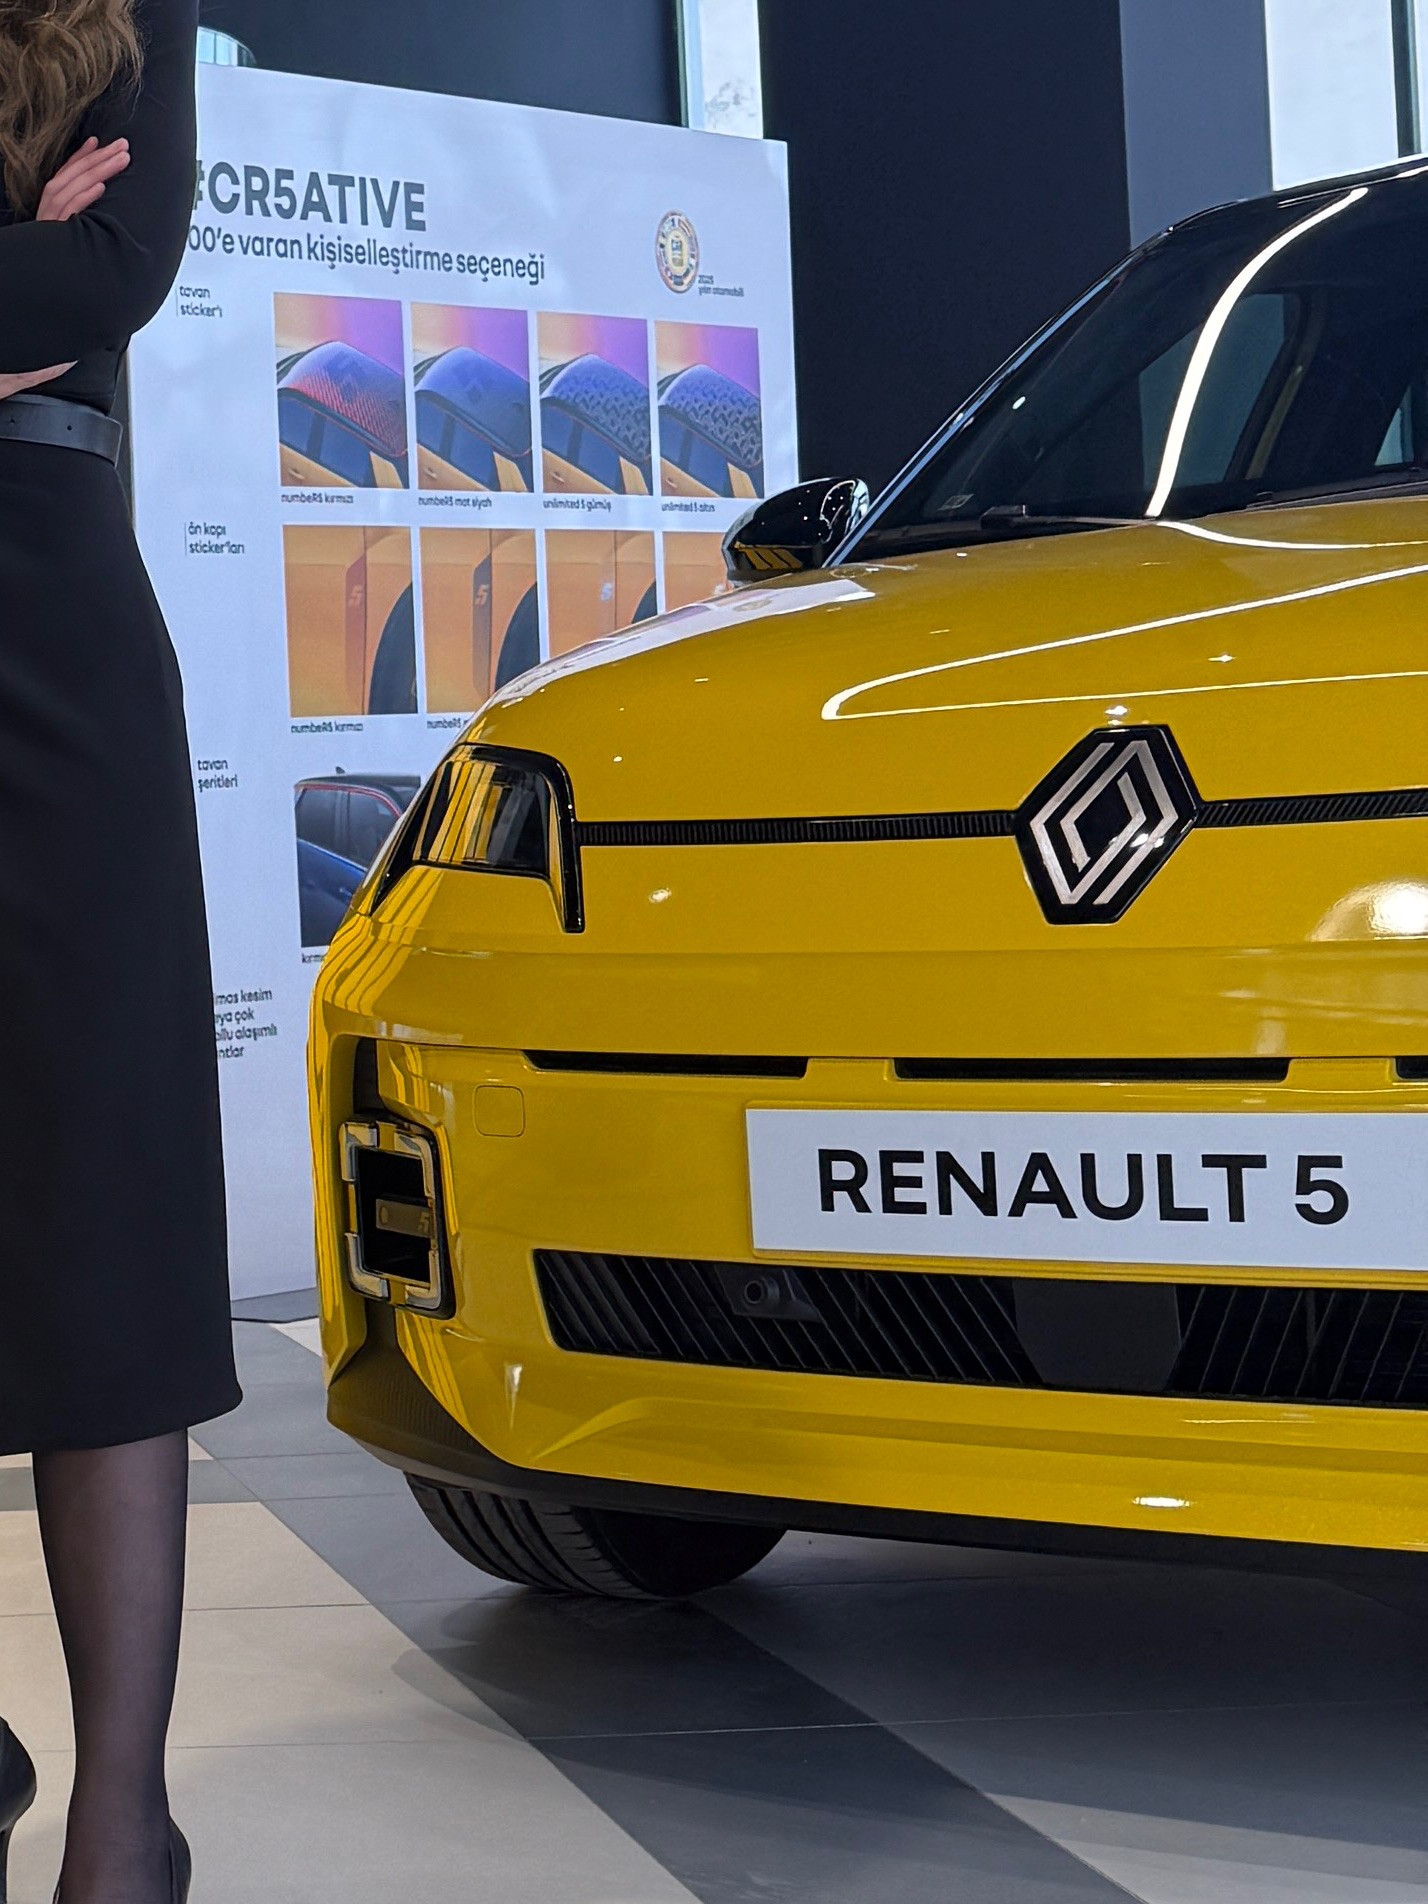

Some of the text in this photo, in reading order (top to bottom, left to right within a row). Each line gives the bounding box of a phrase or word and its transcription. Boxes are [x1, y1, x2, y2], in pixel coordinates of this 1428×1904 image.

[238, 235, 302, 260] varan
[307, 234, 452, 274] kişiselleştirme
[456, 252, 545, 285] seçeneği
[179, 286, 210, 298] tavan
[188, 521, 202, 535] ön
[197, 760, 228, 771] tavan
[240, 988, 272, 1002] kesim
[234, 1007, 254, 1025] çok
[818, 1148, 1350, 1226] RENAULT 5
